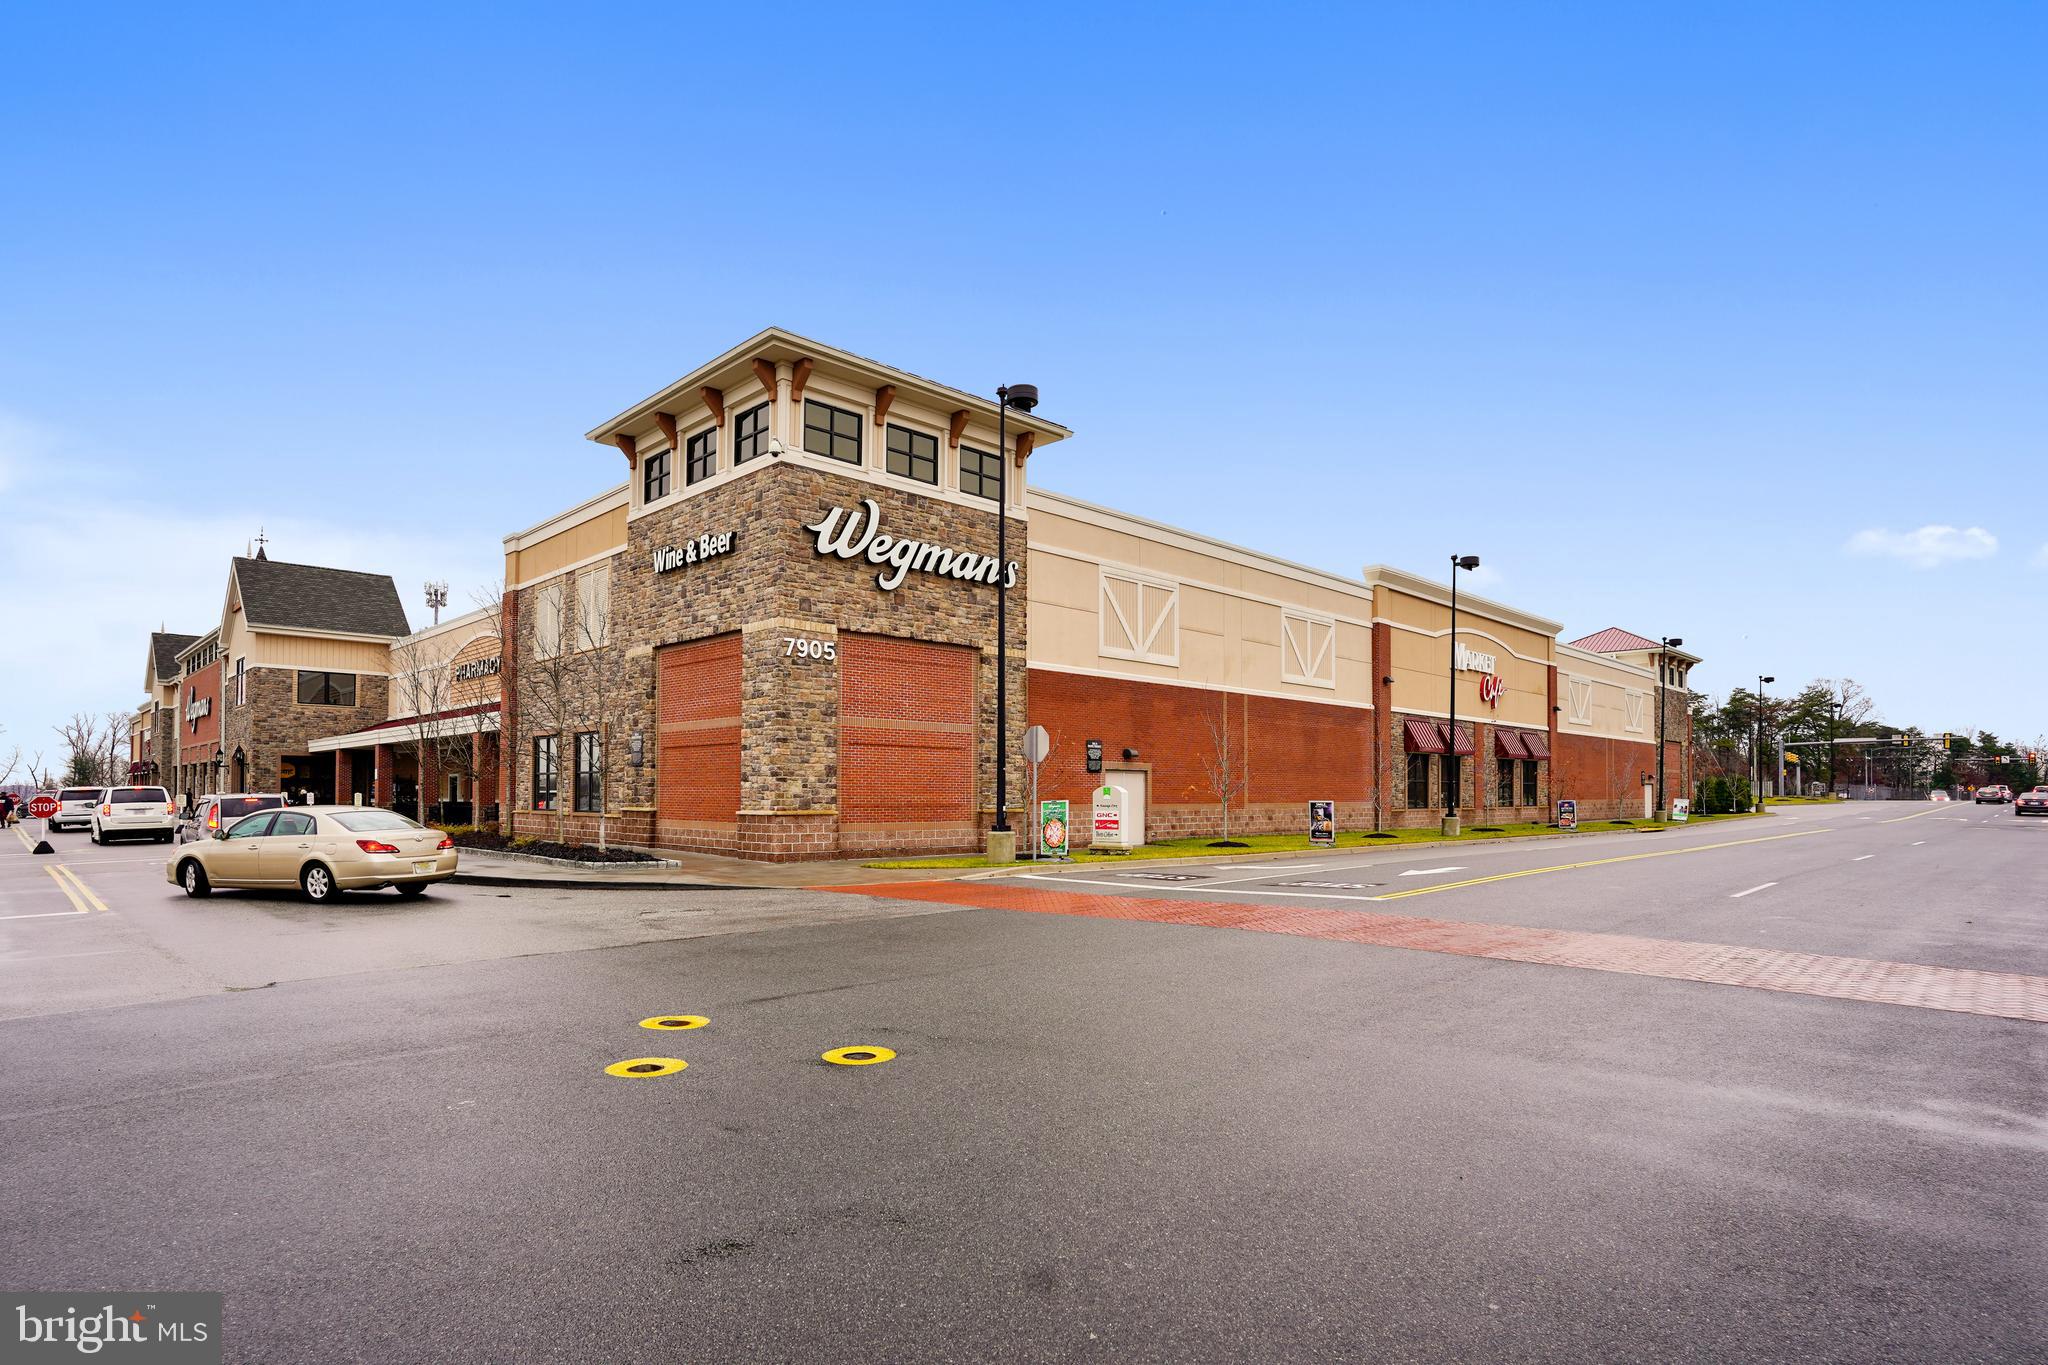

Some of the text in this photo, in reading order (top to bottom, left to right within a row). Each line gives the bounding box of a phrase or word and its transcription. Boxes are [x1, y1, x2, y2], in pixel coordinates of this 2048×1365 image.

[653, 531, 733, 573] Wine & Beer
[804, 499, 1019, 591] Wegmans
[783, 637, 836, 660] 7905
[456, 655, 502, 681] PHARMACY
[185, 686, 210, 734] Wegmans
[30, 803, 57, 812] STOP
